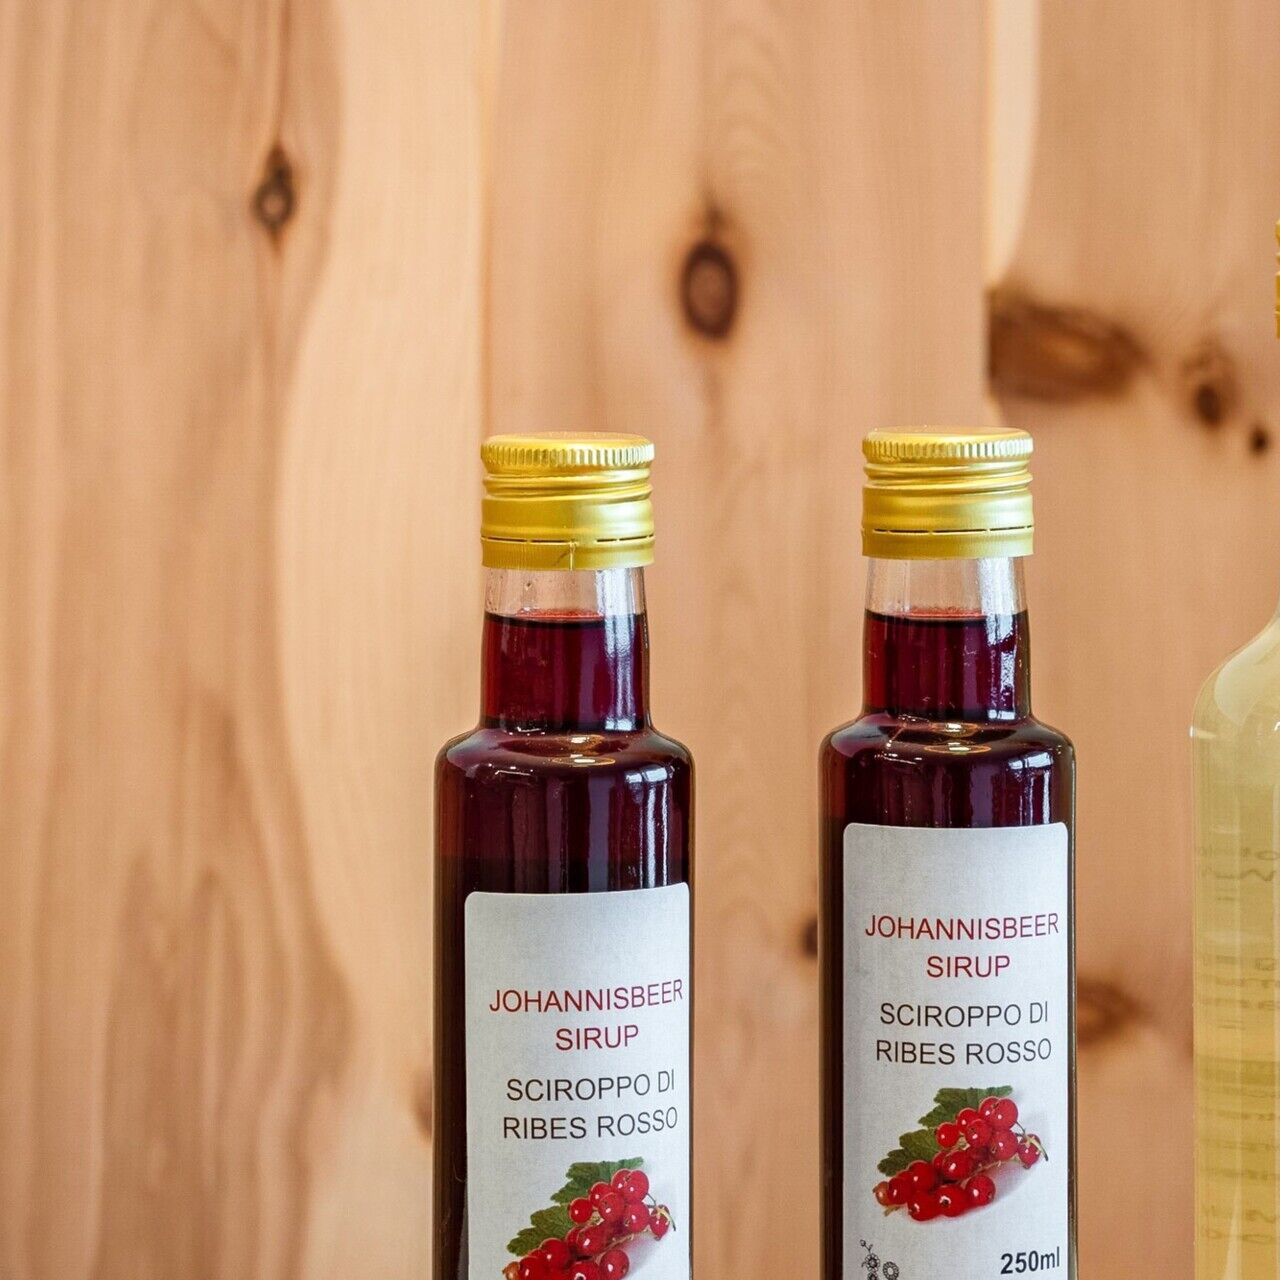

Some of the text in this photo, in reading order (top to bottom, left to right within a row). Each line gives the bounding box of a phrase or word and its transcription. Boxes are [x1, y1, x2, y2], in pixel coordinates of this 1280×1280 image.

[865, 912, 1059, 940] JOHANNISBEER
[926, 955, 1010, 978] SIRUP
[489, 979, 683, 1013] JOHANNISBEER
[880, 1001, 1048, 1027] SCIROPPO DI
[555, 1024, 639, 1051] SIRUP
[876, 1038, 1052, 1065] RIBES ROSSO
[506, 1069, 675, 1102] SCIROPPO DI
[503, 1107, 678, 1140] RIBES ROSSO
[1000, 1247, 1060, 1275] 250ml
